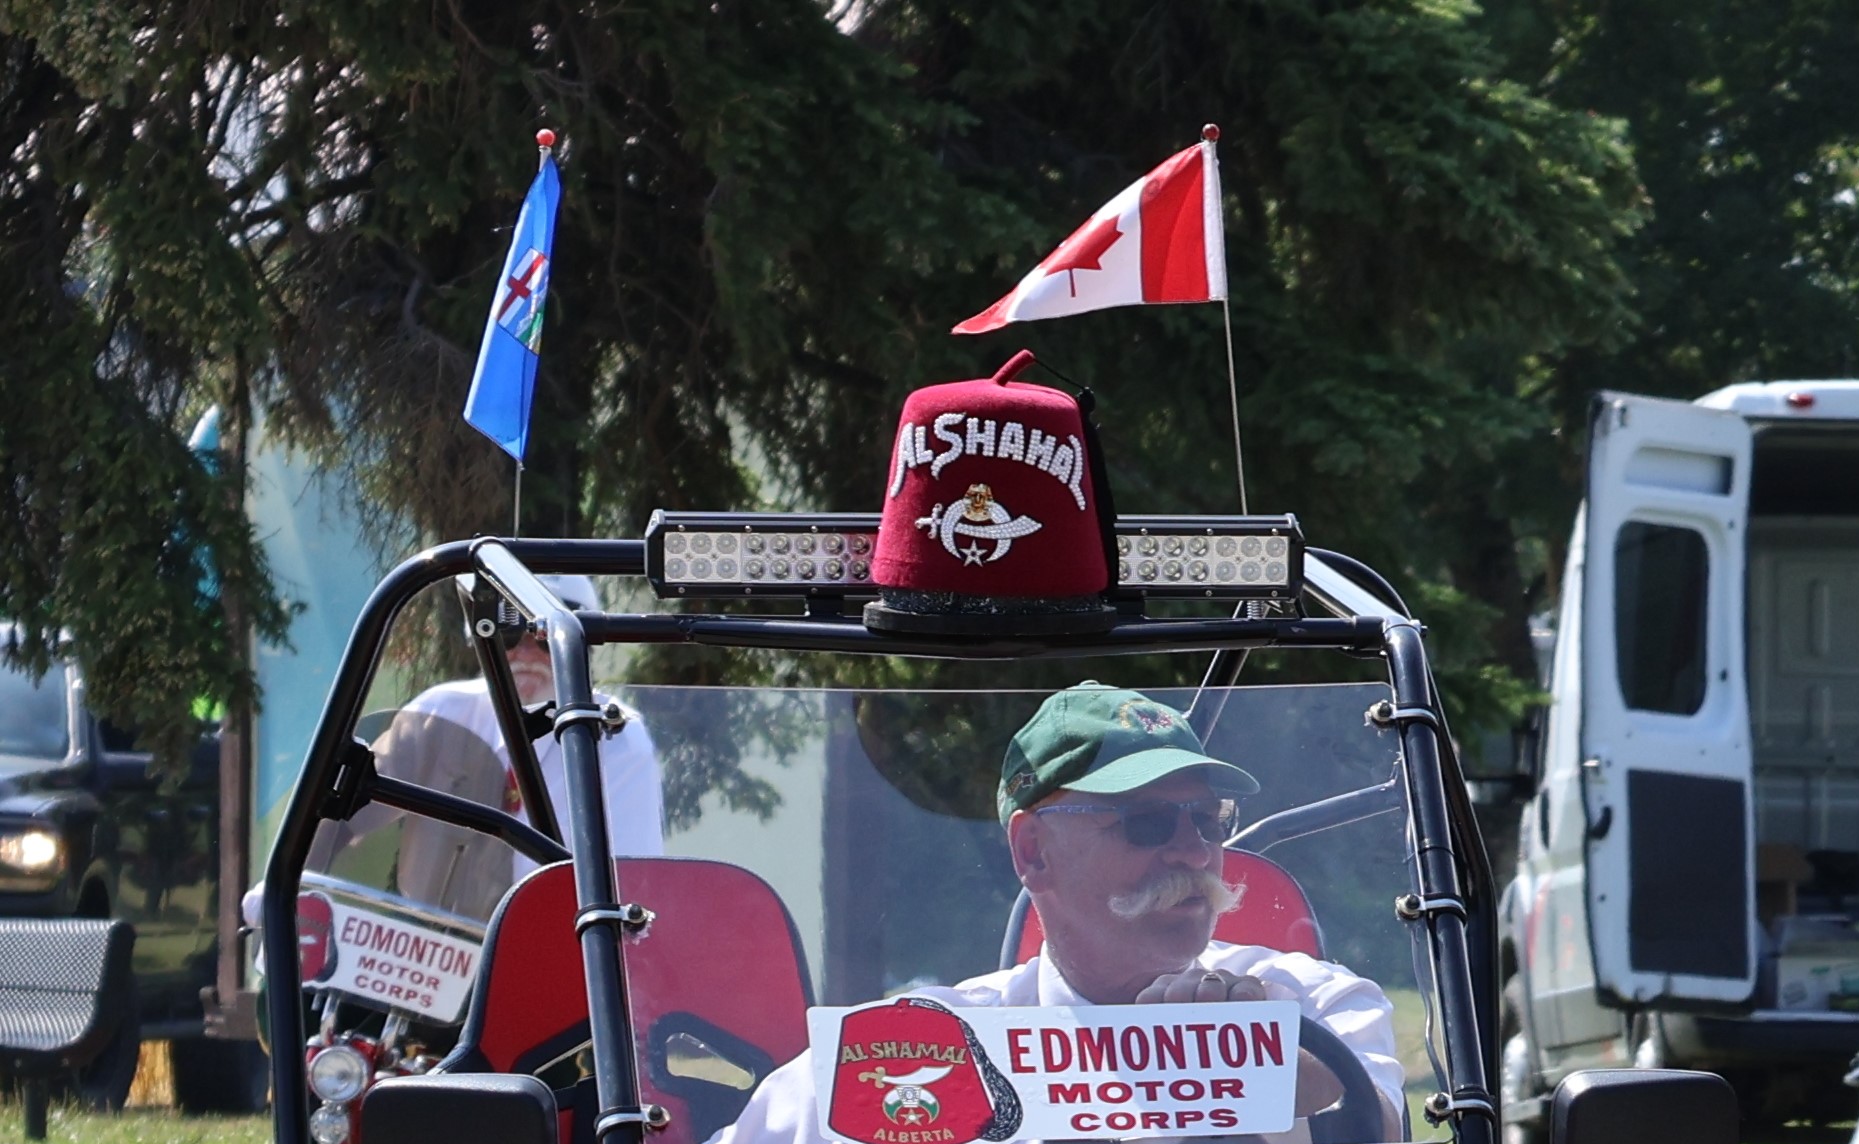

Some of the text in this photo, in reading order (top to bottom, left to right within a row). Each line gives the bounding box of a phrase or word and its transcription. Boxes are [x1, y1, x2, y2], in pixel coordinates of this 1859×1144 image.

[889, 421, 933, 498] AL
[341, 915, 473, 979] EDMONTON
[357, 955, 441, 991] MOTOR
[354, 974, 433, 1009] CORPS
[840, 1041, 967, 1065] AL SHAMAL
[1006, 1021, 1285, 1074] EDMONTON
[1047, 1078, 1246, 1104] MOTOR
[872, 1128, 956, 1144] ALBERTA
[1070, 1108, 1239, 1132] CORPS
